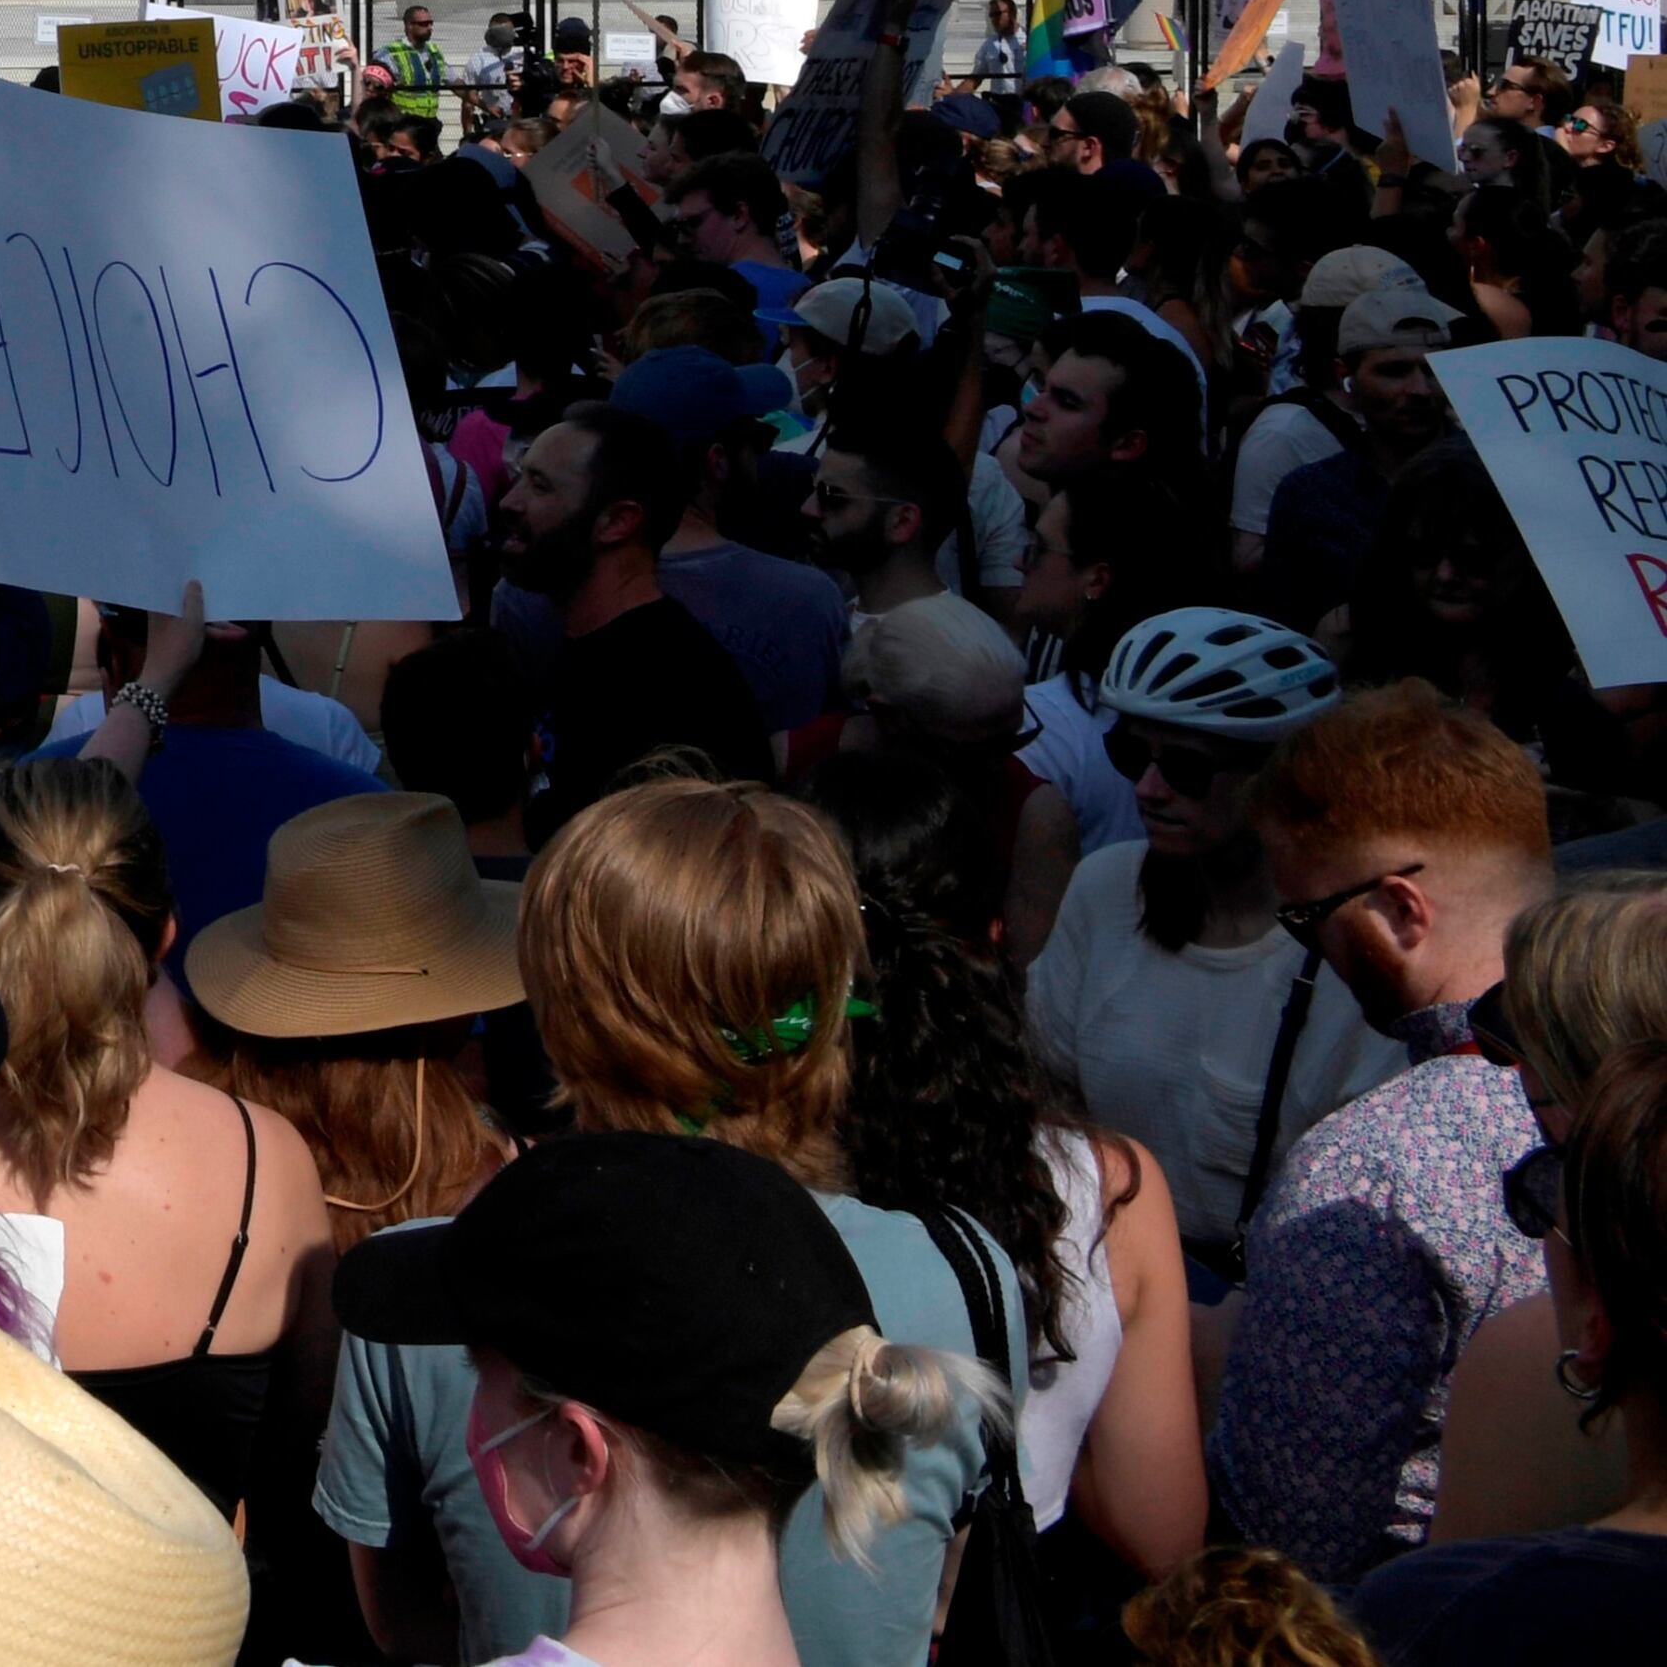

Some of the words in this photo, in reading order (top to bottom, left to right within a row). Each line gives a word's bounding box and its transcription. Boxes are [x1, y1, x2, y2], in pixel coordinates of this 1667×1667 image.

[1514, 0, 1599, 25] ABORTION
[105, 26, 158, 37] ABORTION
[1517, 21, 1589, 52] SAVES
[78, 37, 200, 60] UNSTOPPABLE
[793, 57, 859, 97] THESE
